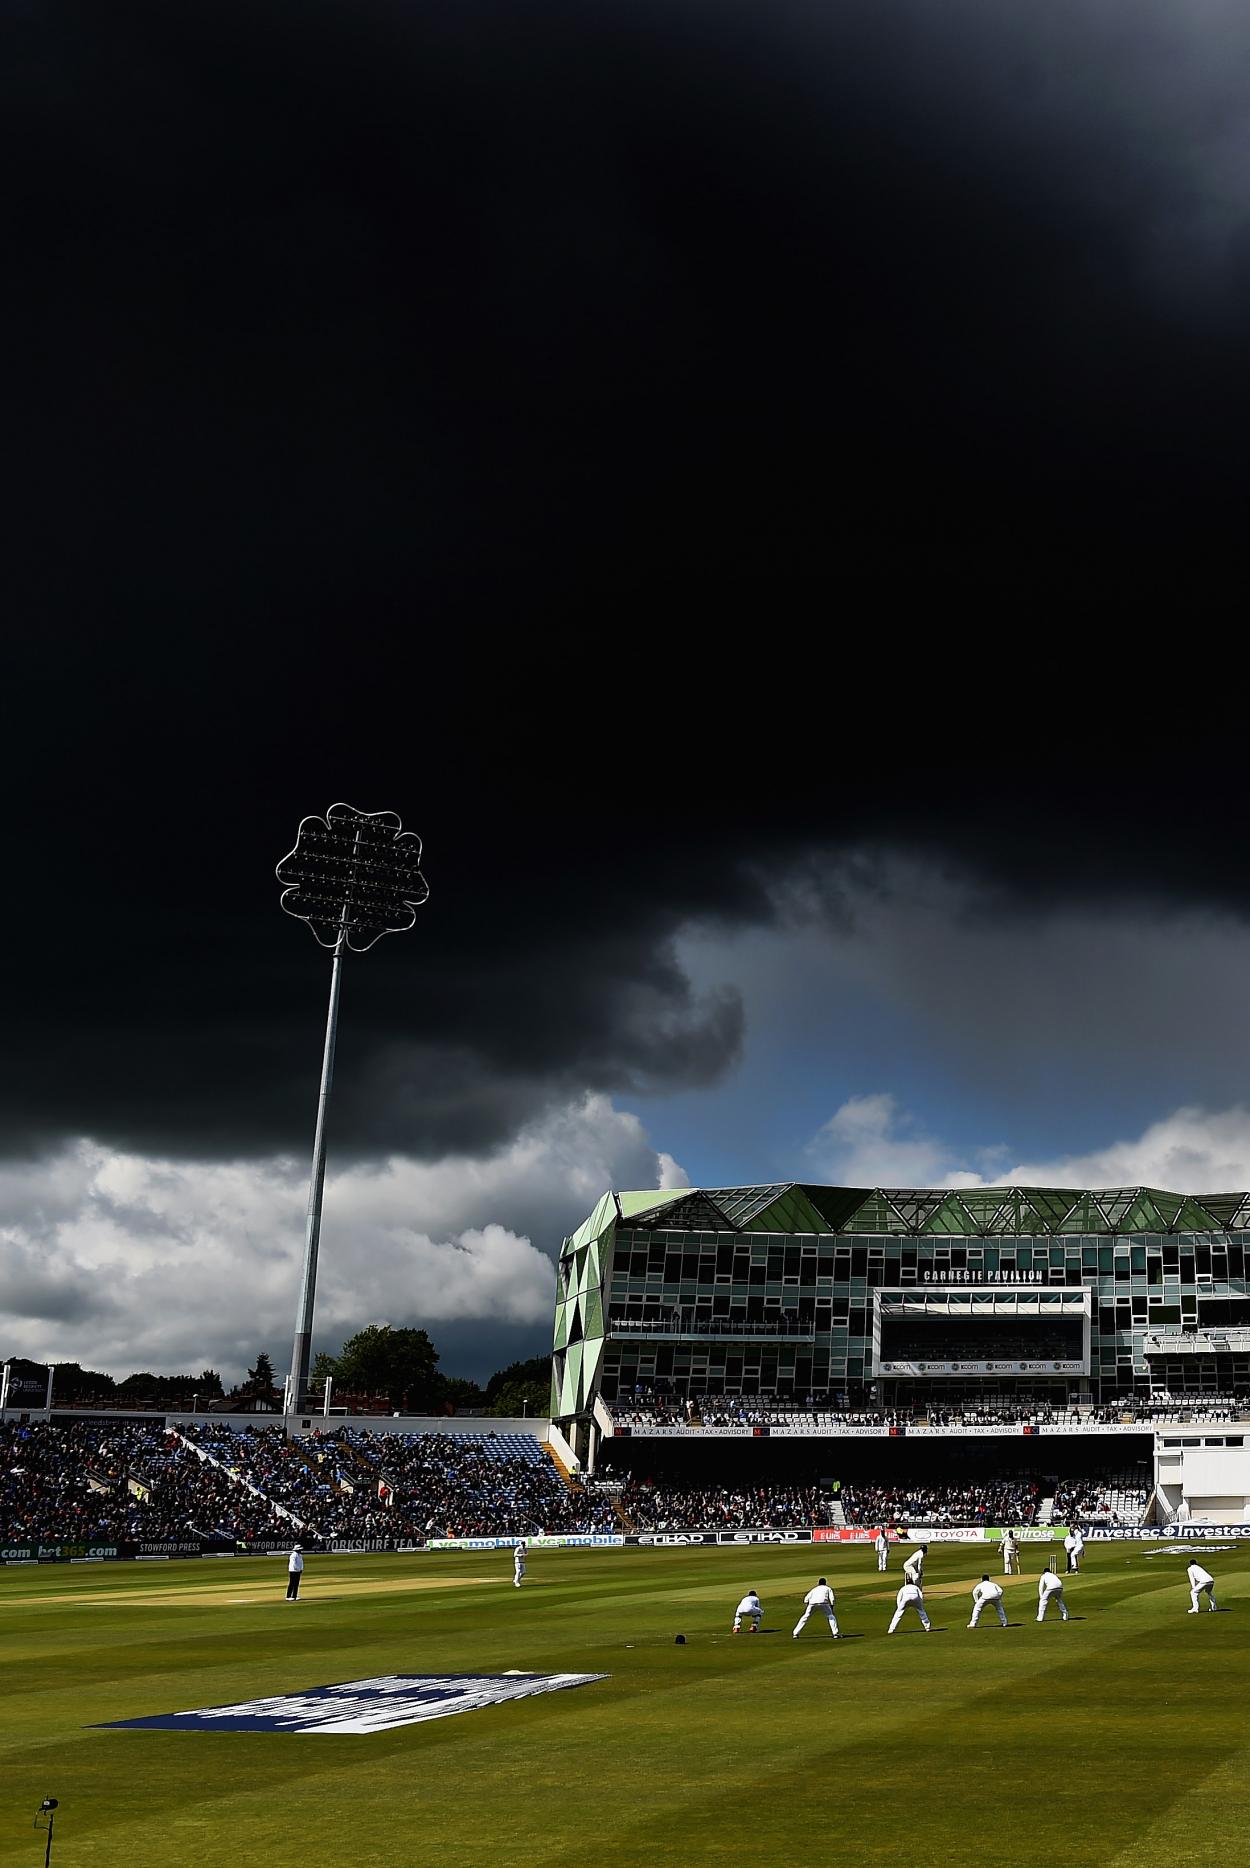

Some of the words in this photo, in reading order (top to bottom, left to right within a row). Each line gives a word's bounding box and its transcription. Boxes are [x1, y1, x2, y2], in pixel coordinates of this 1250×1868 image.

[924, 1270, 983, 1280] CARNEGIE
[987, 1270, 1043, 1280] PAVILION
[734, 1530, 799, 1541] ETIHAD
[934, 1530, 978, 1538] TOYOTA
[1000, 1526, 1055, 1538] Waitrose
[1087, 1526, 1160, 1538] Investec
[1177, 1524, 1250, 1537] Investec
[325, 1539, 390, 1550] YORKSHIRE
[393, 1538, 414, 1549] TEA
[528, 1535, 622, 1548] Lycamobile
[638, 1534, 704, 1544] ETIHAD
[140, 1543, 178, 1552] STOWFORD
[179, 1543, 200, 1551] PRESS
